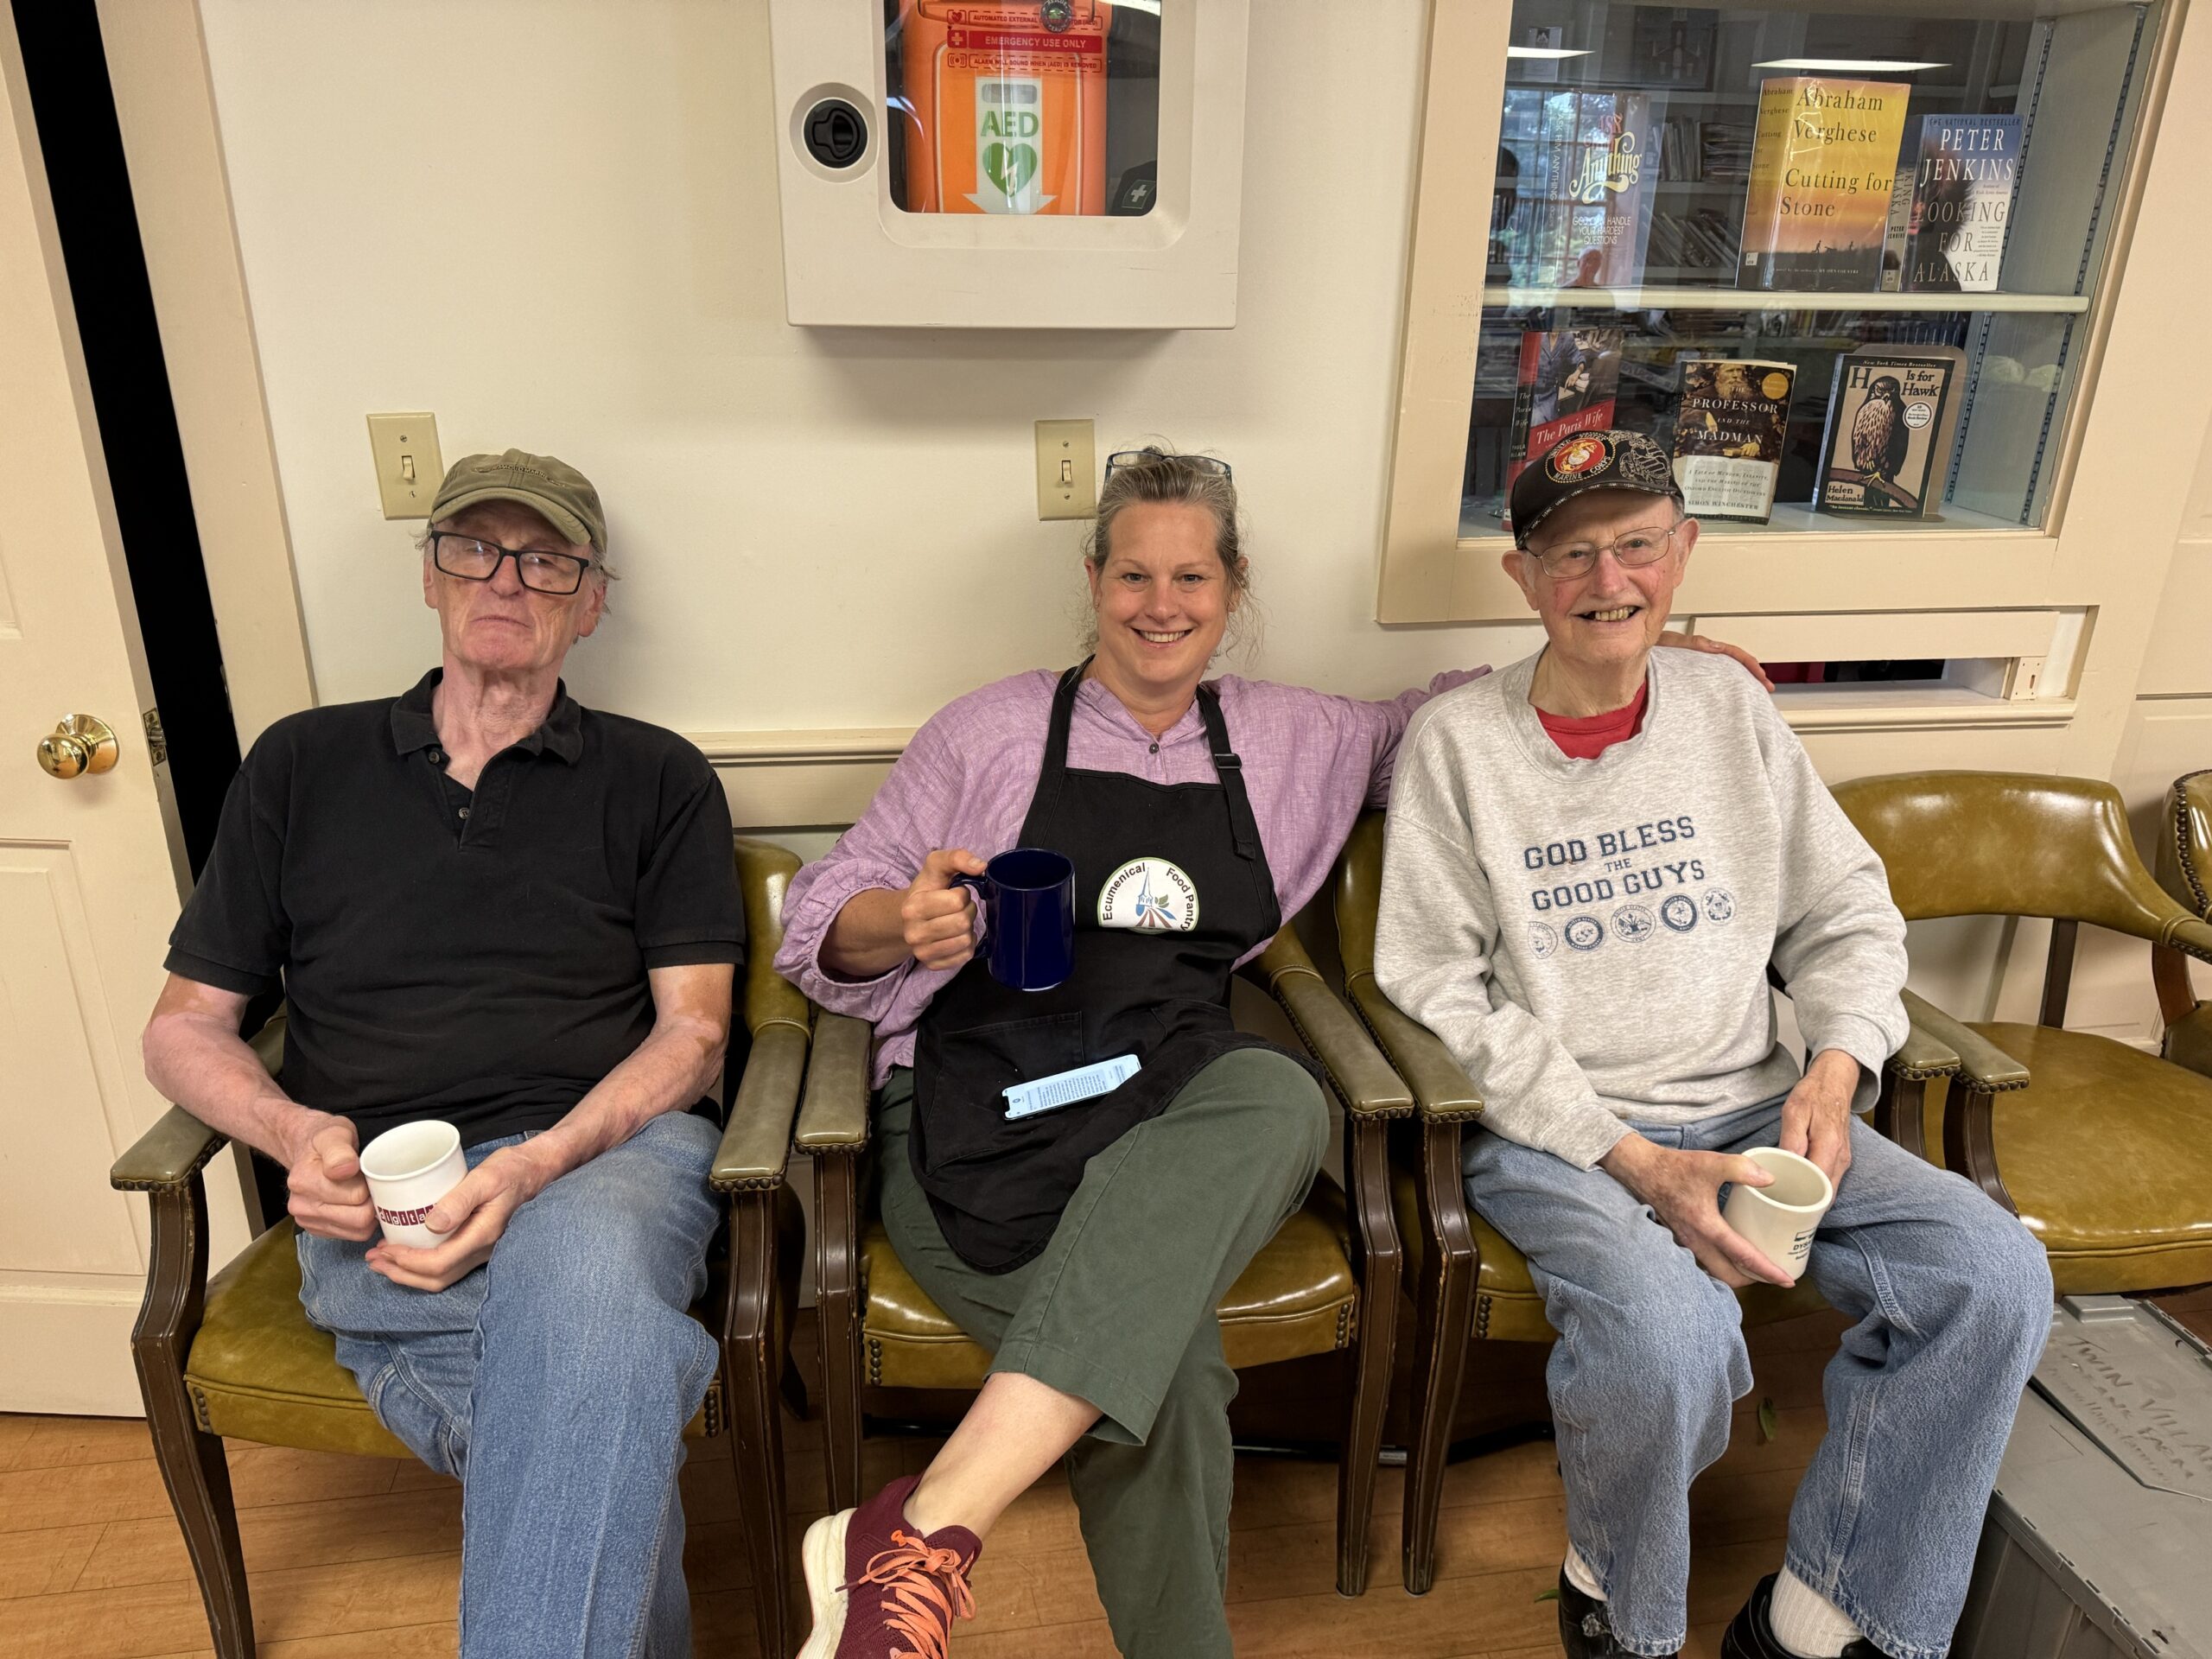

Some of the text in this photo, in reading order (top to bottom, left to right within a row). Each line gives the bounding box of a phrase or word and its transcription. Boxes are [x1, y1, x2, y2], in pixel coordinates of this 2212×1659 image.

[985, 35, 1086, 48] EMERGENCY USE ONLY
[1796, 88, 1883, 111] Abraham
[980, 110, 1039, 138] AED
[1794, 119, 1877, 145] Verghese
[1929, 118, 2021, 127] THE NATIONAL BESTSELLER
[1940, 128, 2005, 151] PETER
[1550, 154, 1560, 201] ANYTHING
[1568, 130, 1642, 205] Anything
[1920, 158, 2013, 188] JENKINS
[1785, 168, 1892, 194] Cutting for
[1780, 196, 1835, 217] Stone
[1916, 201, 2005, 223] LOOKING
[1579, 226, 1624, 235] YOUR HARDEST
[1607, 216, 1631, 226] HANDLE
[1584, 235, 1618, 245] QUESTIONS
[1938, 232, 1974, 252] FOR
[1913, 262, 1989, 283] ALASKA
[1849, 367, 1872, 389] H
[1905, 370, 1936, 382] Is for
[1693, 397, 1778, 414] PROFESSOR
[1536, 409, 1604, 445] The Paris Wife
[1697, 429, 1764, 444] MADMAN
[1590, 455, 1611, 474] CORPS
[1553, 472, 1583, 481] MARINE
[1826, 493, 1864, 503] Macdonald
[1827, 485, 1853, 494] Helen
[1712, 501, 1758, 510] WINCHESTER
[1523, 816, 1695, 870] GOD BLESS
[1604, 857, 1632, 873] THE
[1531, 860, 1705, 911] GOOD GUYS
[1103, 862, 1195, 931] Ecumenical Food Pantry
[379, 1208, 434, 1225] digita
[2068, 1337, 2133, 1388] TWIN
